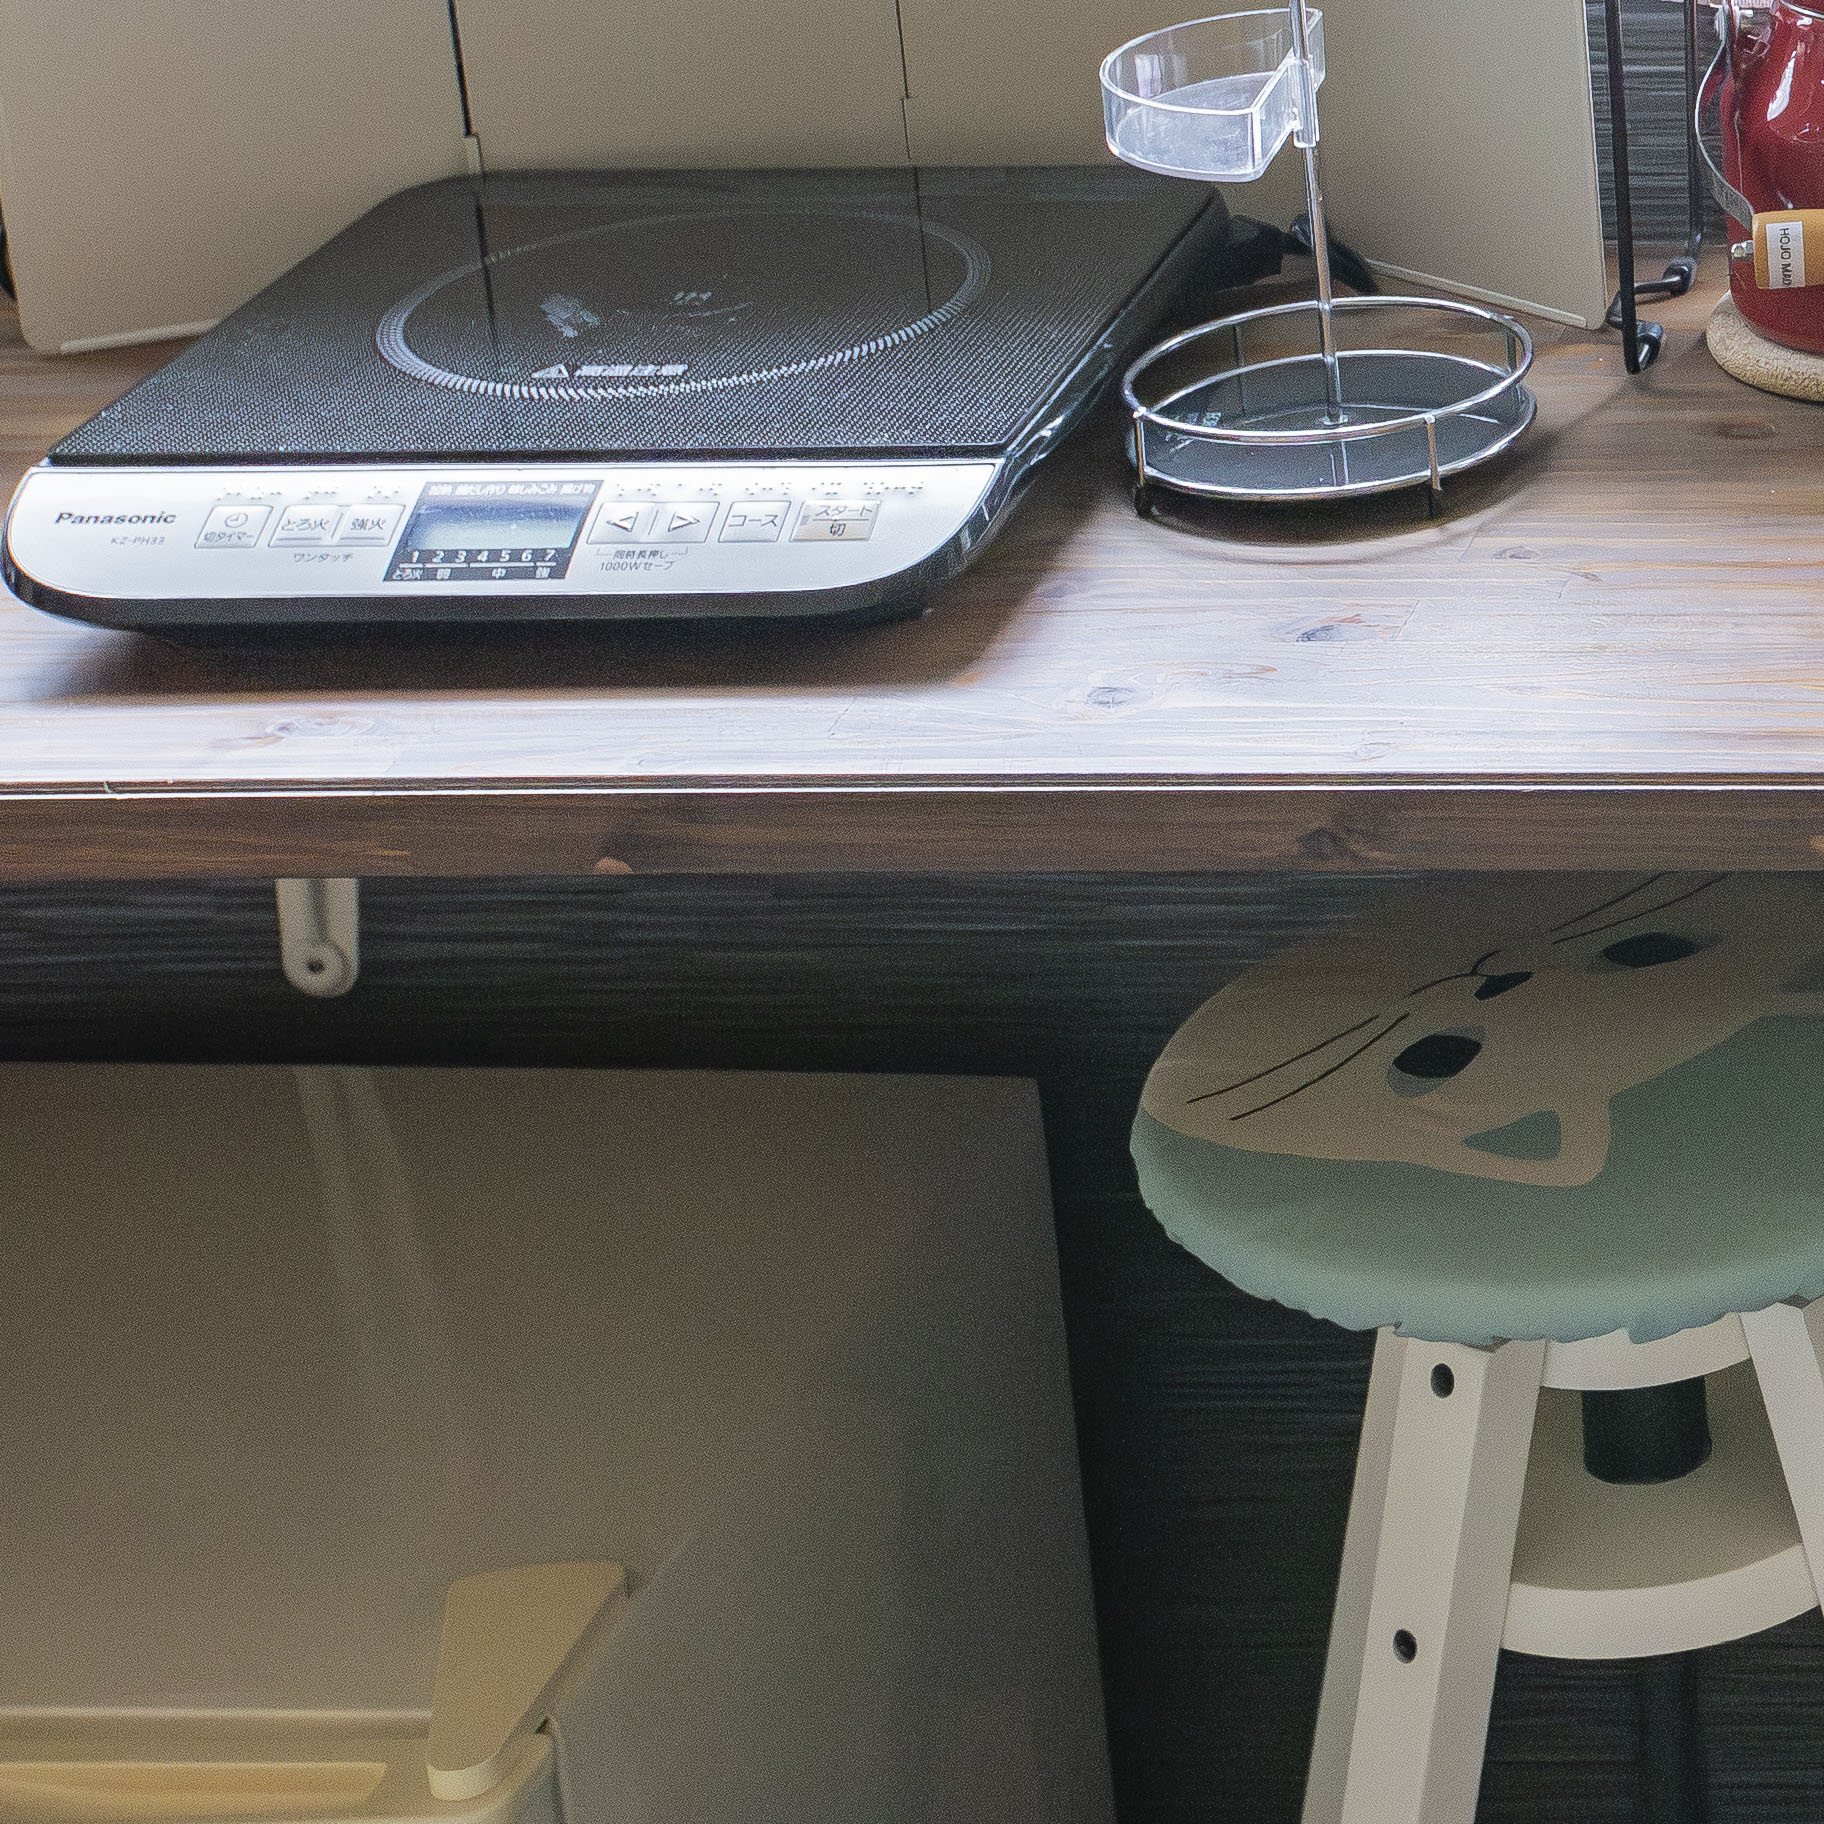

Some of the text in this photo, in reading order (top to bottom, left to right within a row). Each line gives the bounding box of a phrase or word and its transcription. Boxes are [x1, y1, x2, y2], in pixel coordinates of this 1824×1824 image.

[1780, 227, 1792, 260] HOJO
[814, 504, 873, 518] スタート
[54, 511, 177, 526] Panasonic
[281, 517, 330, 531] とろ火
[727, 514, 779, 528] コース
[829, 522, 847, 537] 切
